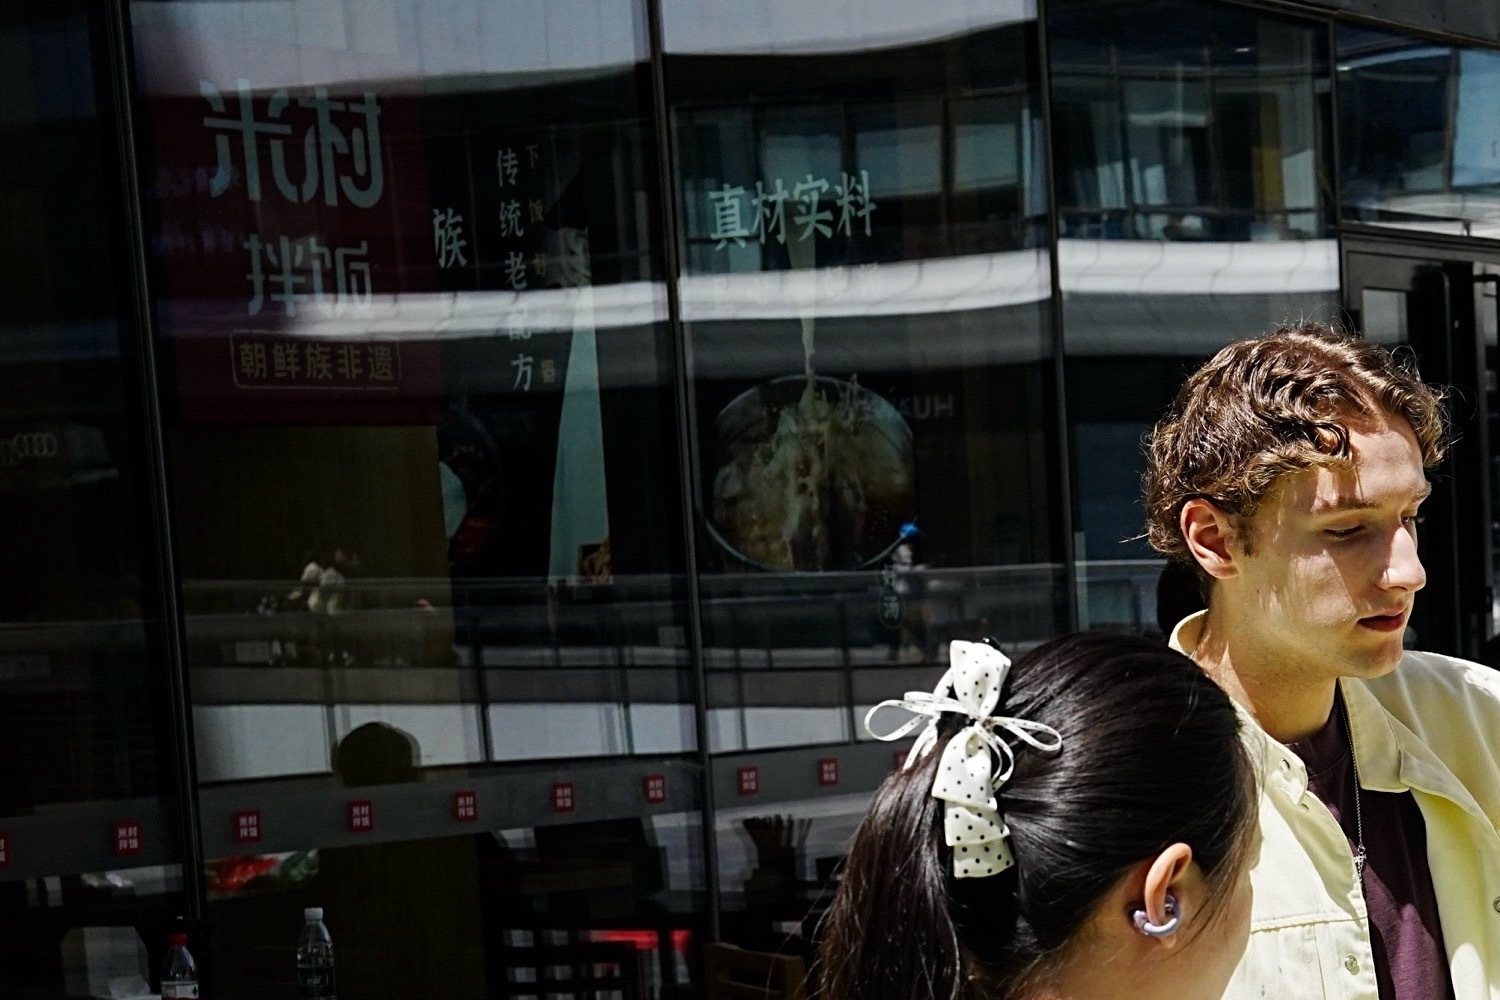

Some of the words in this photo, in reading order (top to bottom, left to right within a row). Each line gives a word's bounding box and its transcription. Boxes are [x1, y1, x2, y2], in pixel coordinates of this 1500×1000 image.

[199, 78, 385, 210] 米村
[708, 169, 878, 252] 真材实料
[243, 233, 374, 317] 拌饭
[239, 341, 394, 383] 朝鲜族非遗
